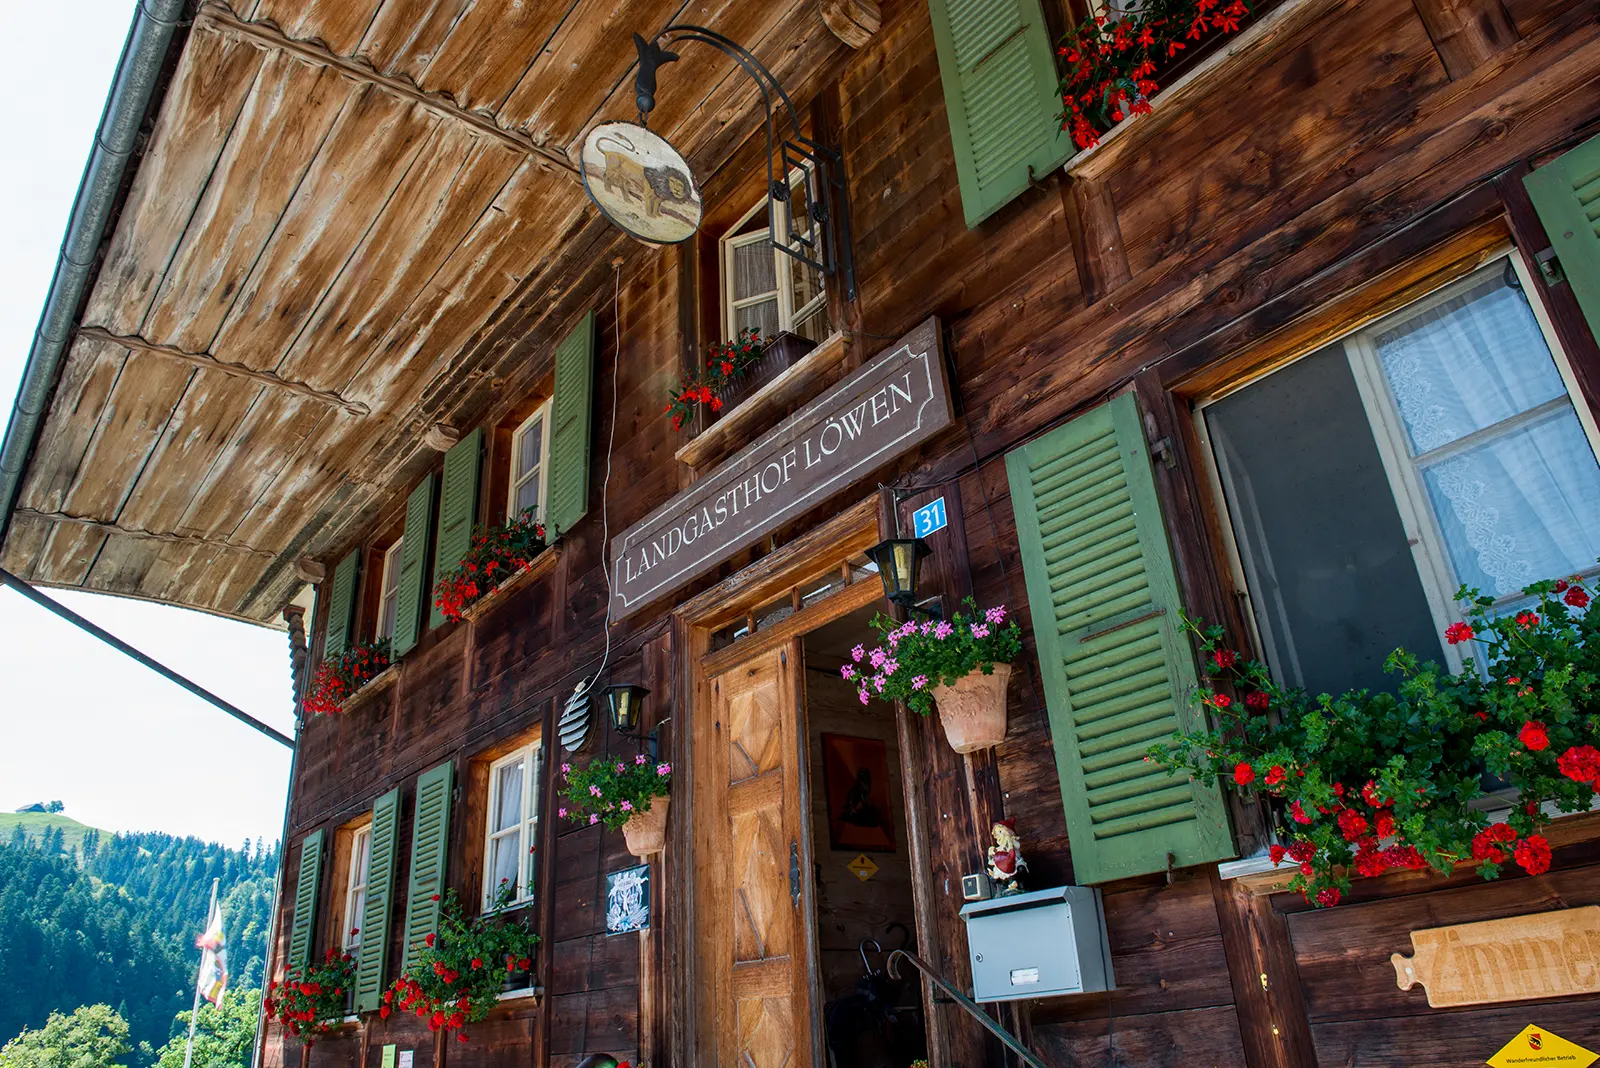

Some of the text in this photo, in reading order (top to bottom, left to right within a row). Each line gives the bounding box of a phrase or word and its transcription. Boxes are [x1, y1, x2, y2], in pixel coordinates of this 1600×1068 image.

[625, 372, 913, 584] LANDGASTHOF LÖWEN
[920, 503, 941, 533] 31
[1505, 1054, 1577, 1064] Wanderfreundlicher Betrieb
